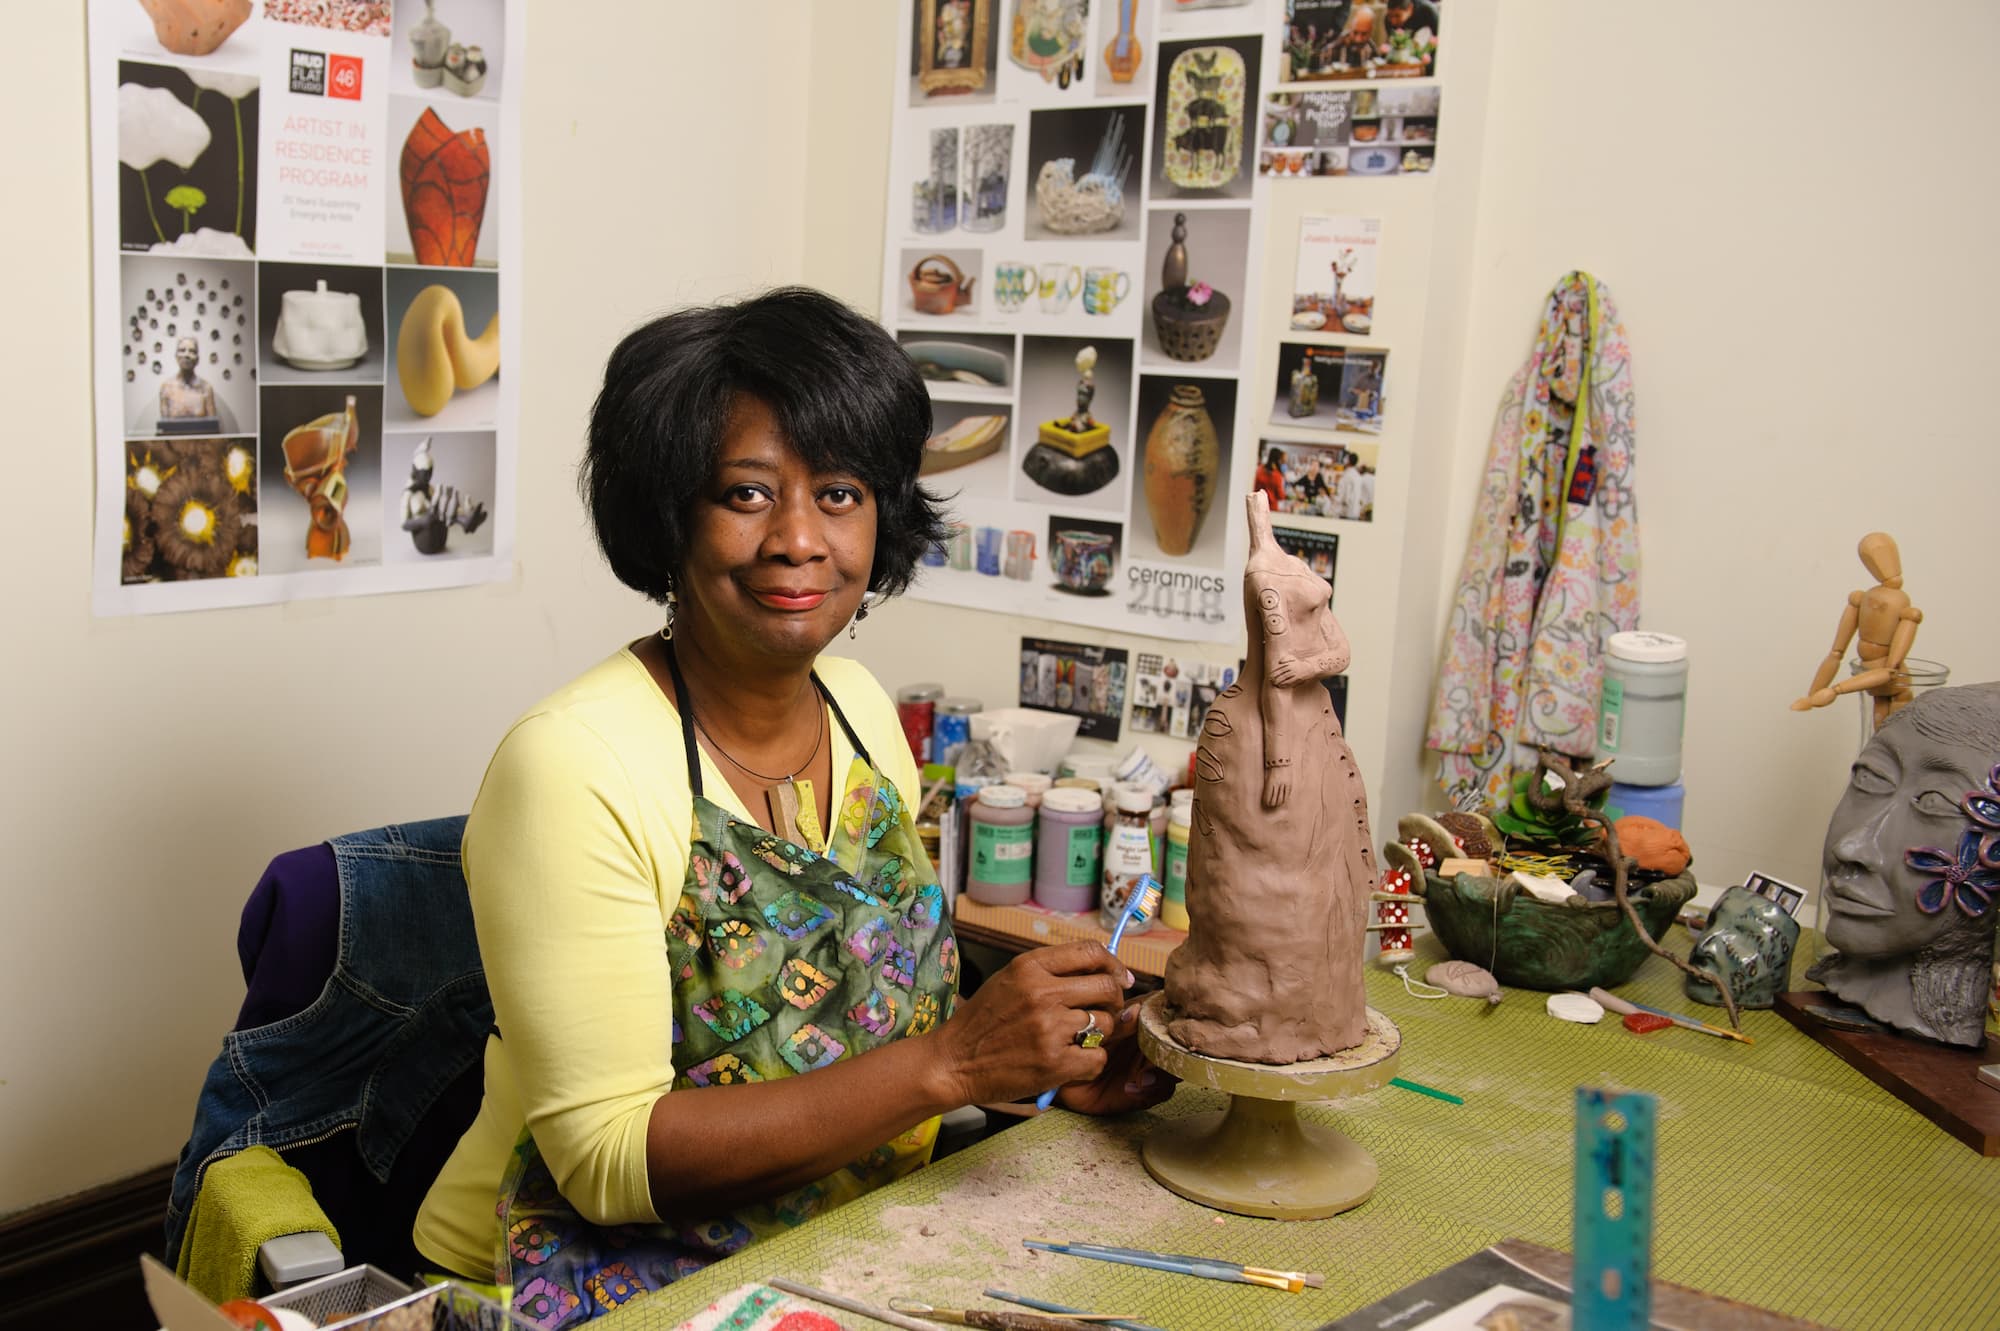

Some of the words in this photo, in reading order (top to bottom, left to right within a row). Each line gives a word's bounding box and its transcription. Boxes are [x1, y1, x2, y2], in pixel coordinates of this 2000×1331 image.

[293, 52, 323, 69] MUD
[292, 66, 323, 83] FLAT
[282, 114, 343, 137] ARTIST
[348, 120, 366, 140] IN
[275, 140, 373, 166] RESIDENCE
[280, 166, 368, 190] PROGRAM
[1127, 566, 1225, 593] ceramics
[1127, 580, 1222, 625] 2018
